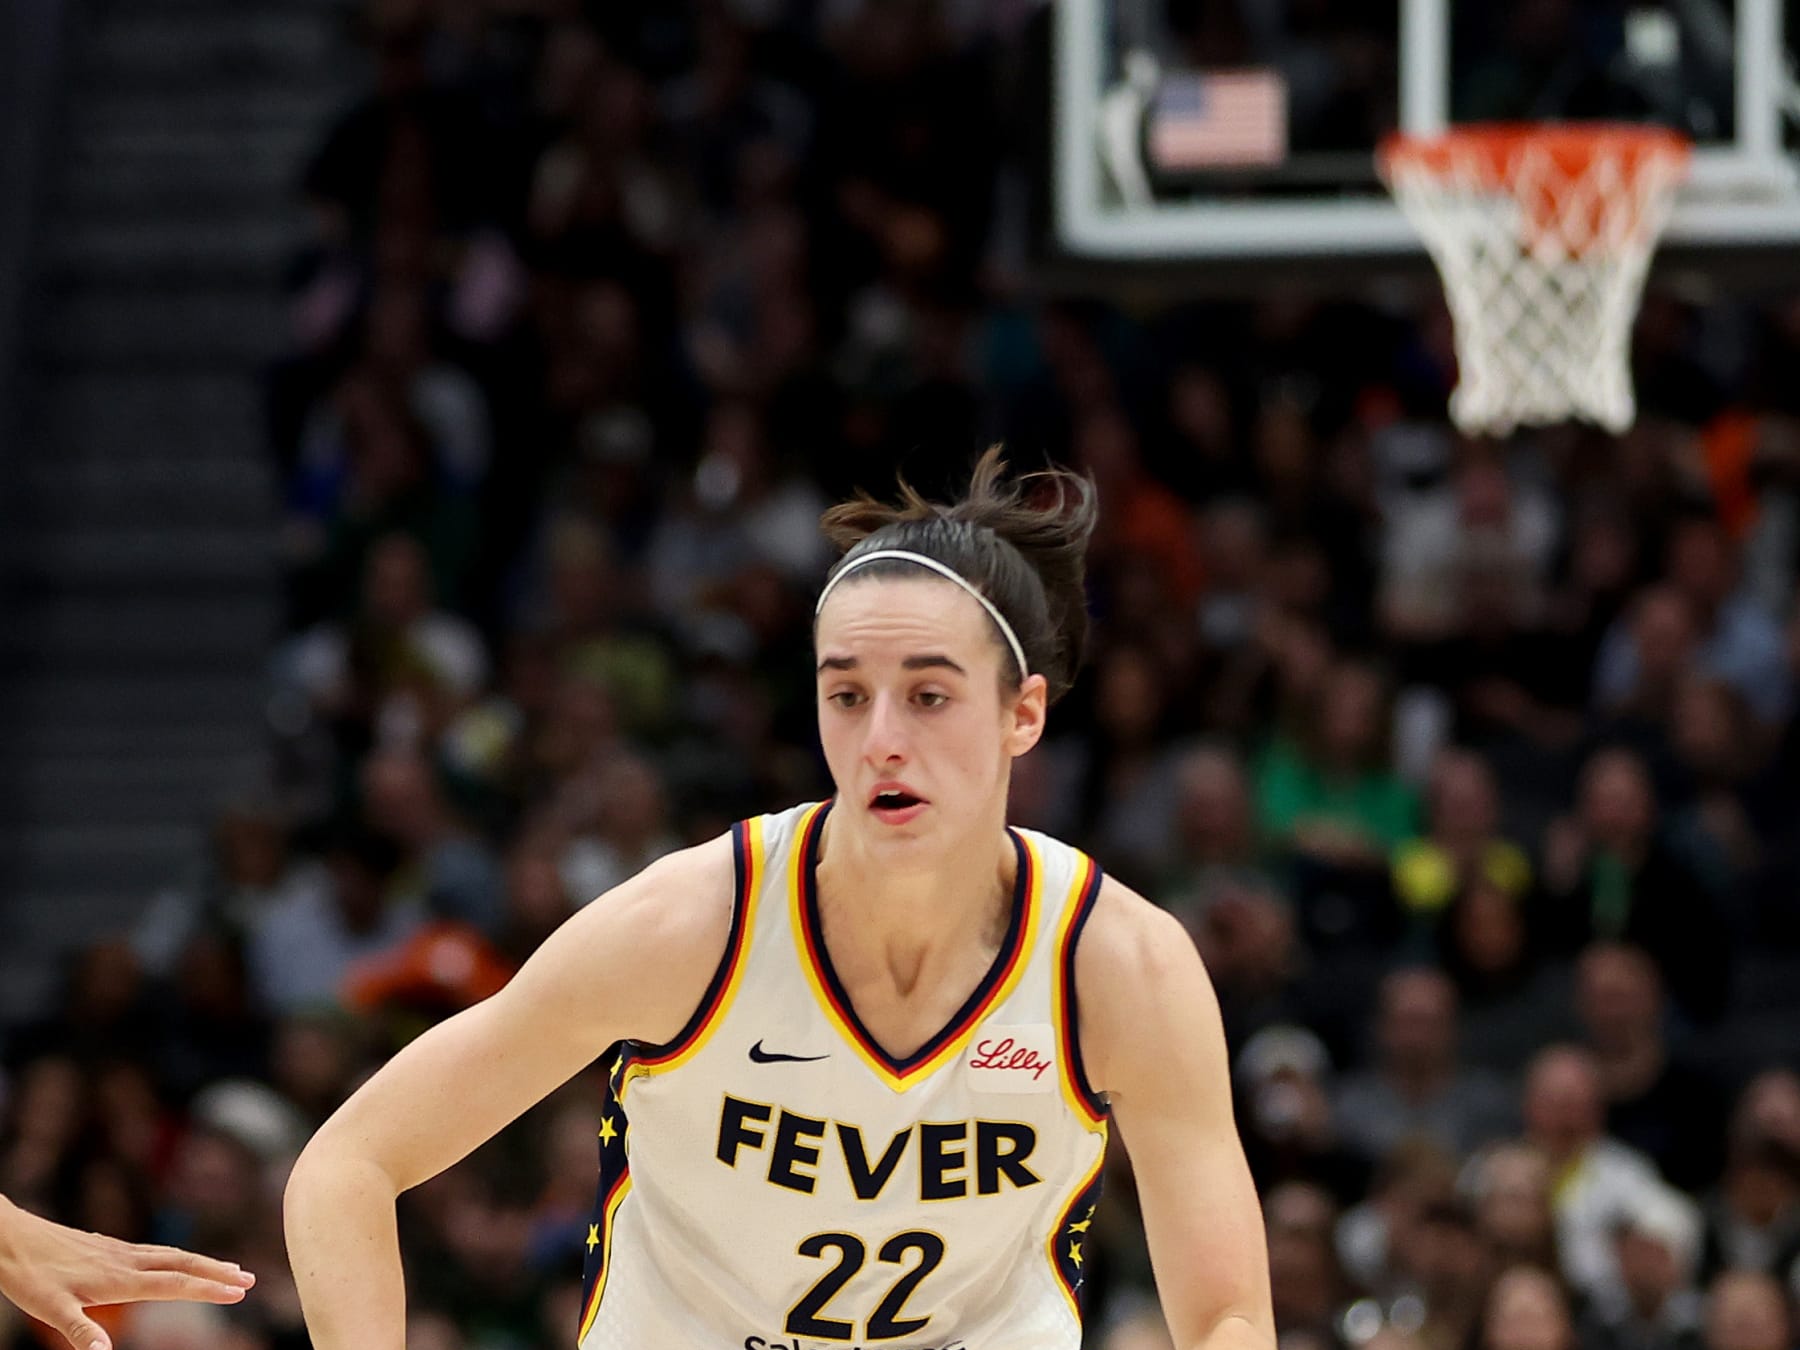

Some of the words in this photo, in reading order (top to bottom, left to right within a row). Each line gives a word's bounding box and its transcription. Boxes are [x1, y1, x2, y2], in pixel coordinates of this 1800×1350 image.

[969, 1037, 1053, 1081] Lilly
[715, 1091, 1043, 1203] FEVER
[782, 1227, 946, 1344] 22
